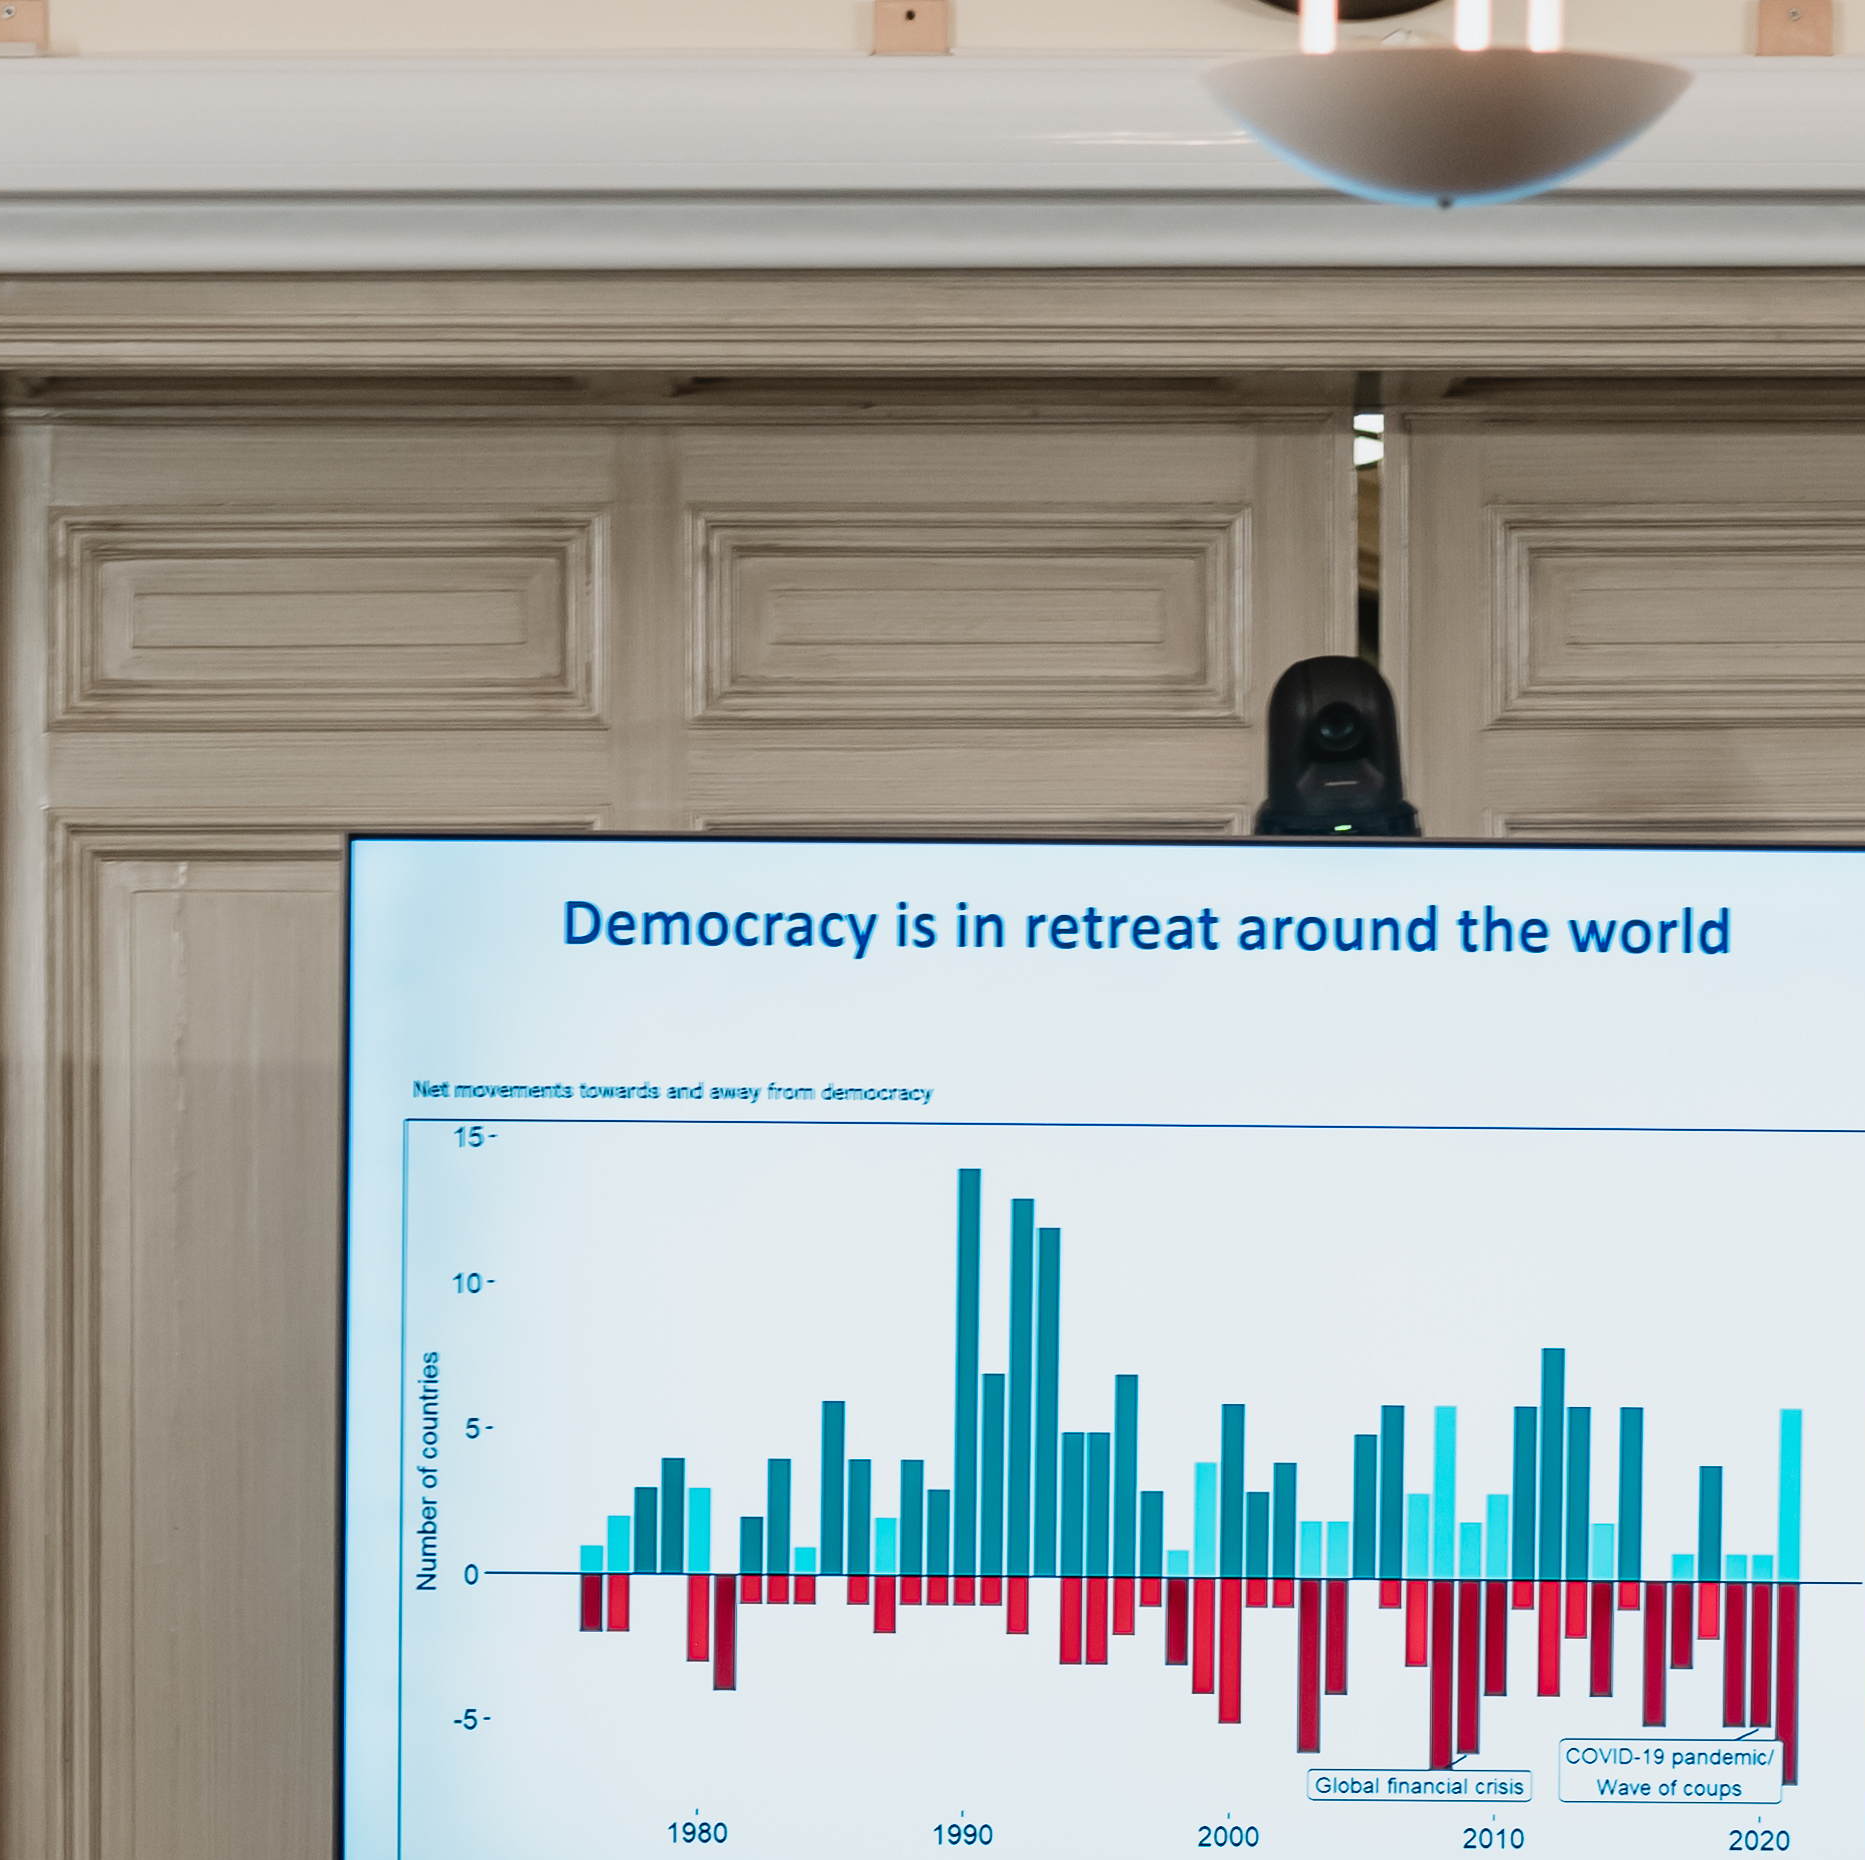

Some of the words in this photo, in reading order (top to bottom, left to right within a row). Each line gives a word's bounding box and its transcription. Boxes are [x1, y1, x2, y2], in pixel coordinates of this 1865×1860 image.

[564, 901, 879, 959] Democracy
[896, 901, 937, 948] is
[956, 902, 1005, 948] in
[1026, 906, 1220, 950] retreat
[1237, 905, 1438, 952] around
[1456, 905, 1550, 953] the
[1567, 907, 1731, 955] world
[412, 1080, 450, 1099] Net
[454, 1081, 574, 1100] movements
[578, 1081, 660, 1100] towards
[667, 1082, 703, 1100] and
[709, 1085, 762, 1104] away
[767, 1083, 816, 1101] from
[821, 1083, 935, 1105] democracy
[454, 1126, 486, 1148] 15
[452, 1273, 484, 1295] 10
[417, 1351, 439, 1460] countries
[464, 1417, 481, 1440] 5
[417, 1466, 438, 1490] of
[416, 1496, 438, 1591] Number
[464, 1564, 480, 1586] 0
[453, 1708, 479, 1731] -5
[1566, 1747, 1665, 1766] COVID-19
[1671, 1748, 1775, 1769] pandemic/
[1315, 1776, 1379, 1794] Global
[1387, 1776, 1468, 1795] financial
[1475, 1777, 1525, 1796] crisis
[1597, 1779, 1651, 1797] Wave
[1659, 1778, 1679, 1797] of
[1683, 1782, 1743, 1801] coups
[668, 1822, 728, 1844] 1980
[934, 1824, 993, 1846] 1990
[1198, 1826, 1259, 1847] 2000
[1463, 1828, 1524, 1850] 2010
[1729, 1830, 1790, 1852] 2020
